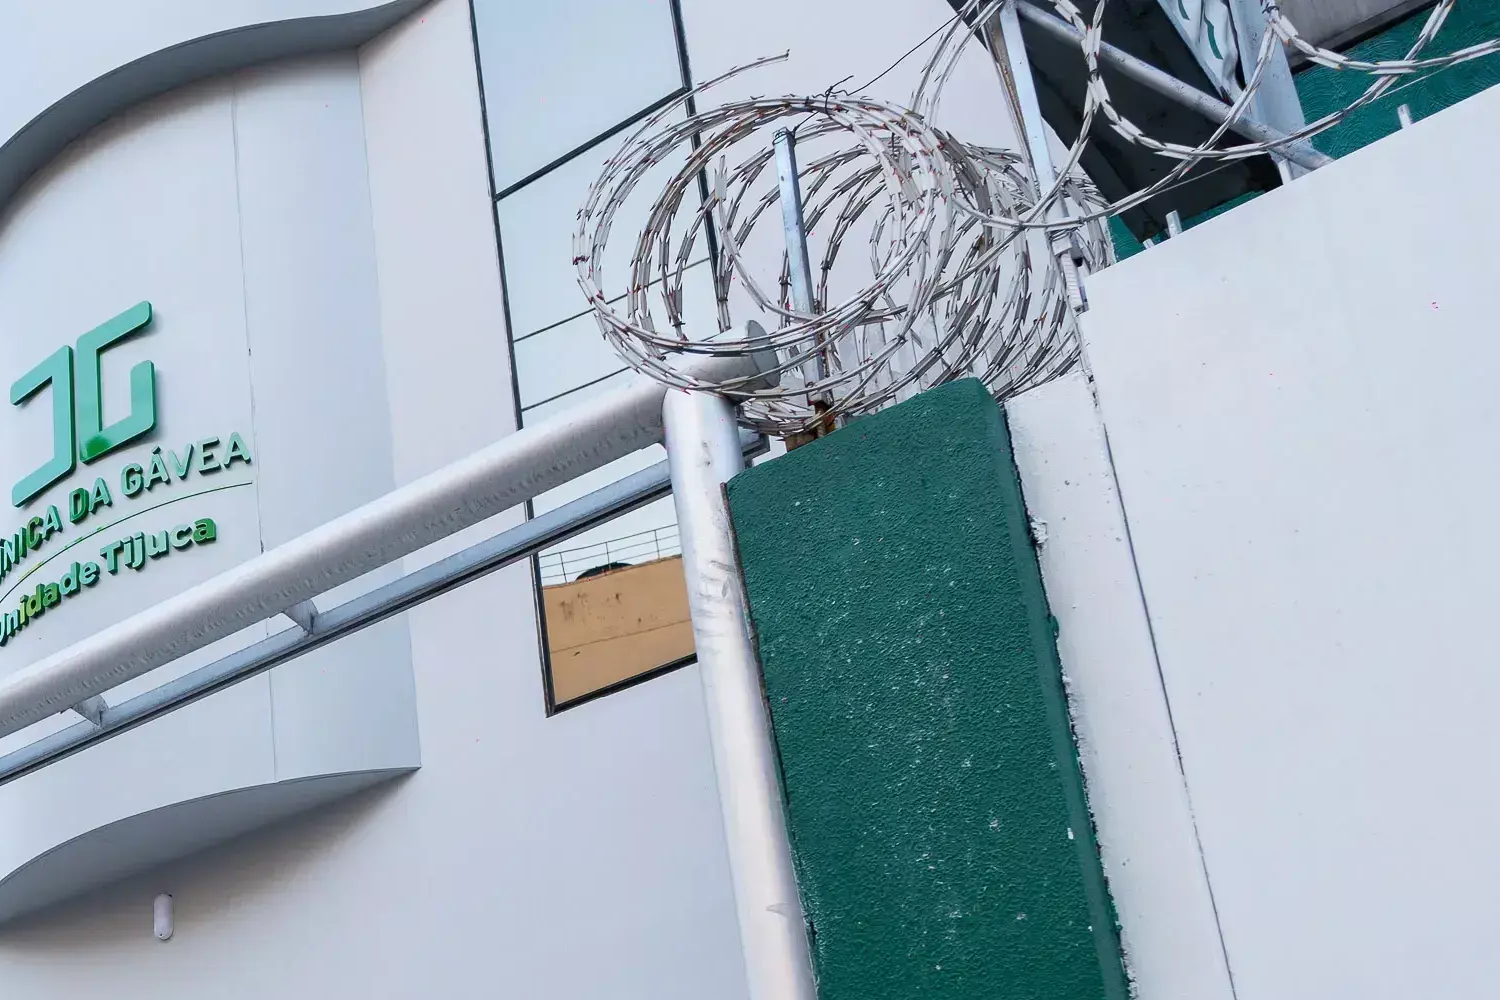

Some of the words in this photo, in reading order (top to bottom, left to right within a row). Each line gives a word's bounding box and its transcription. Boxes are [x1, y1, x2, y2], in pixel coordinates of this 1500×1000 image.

[69, 477, 113, 523] DA
[120, 431, 252, 498] GÁVEA
[100, 517, 217, 575] Tijuca
